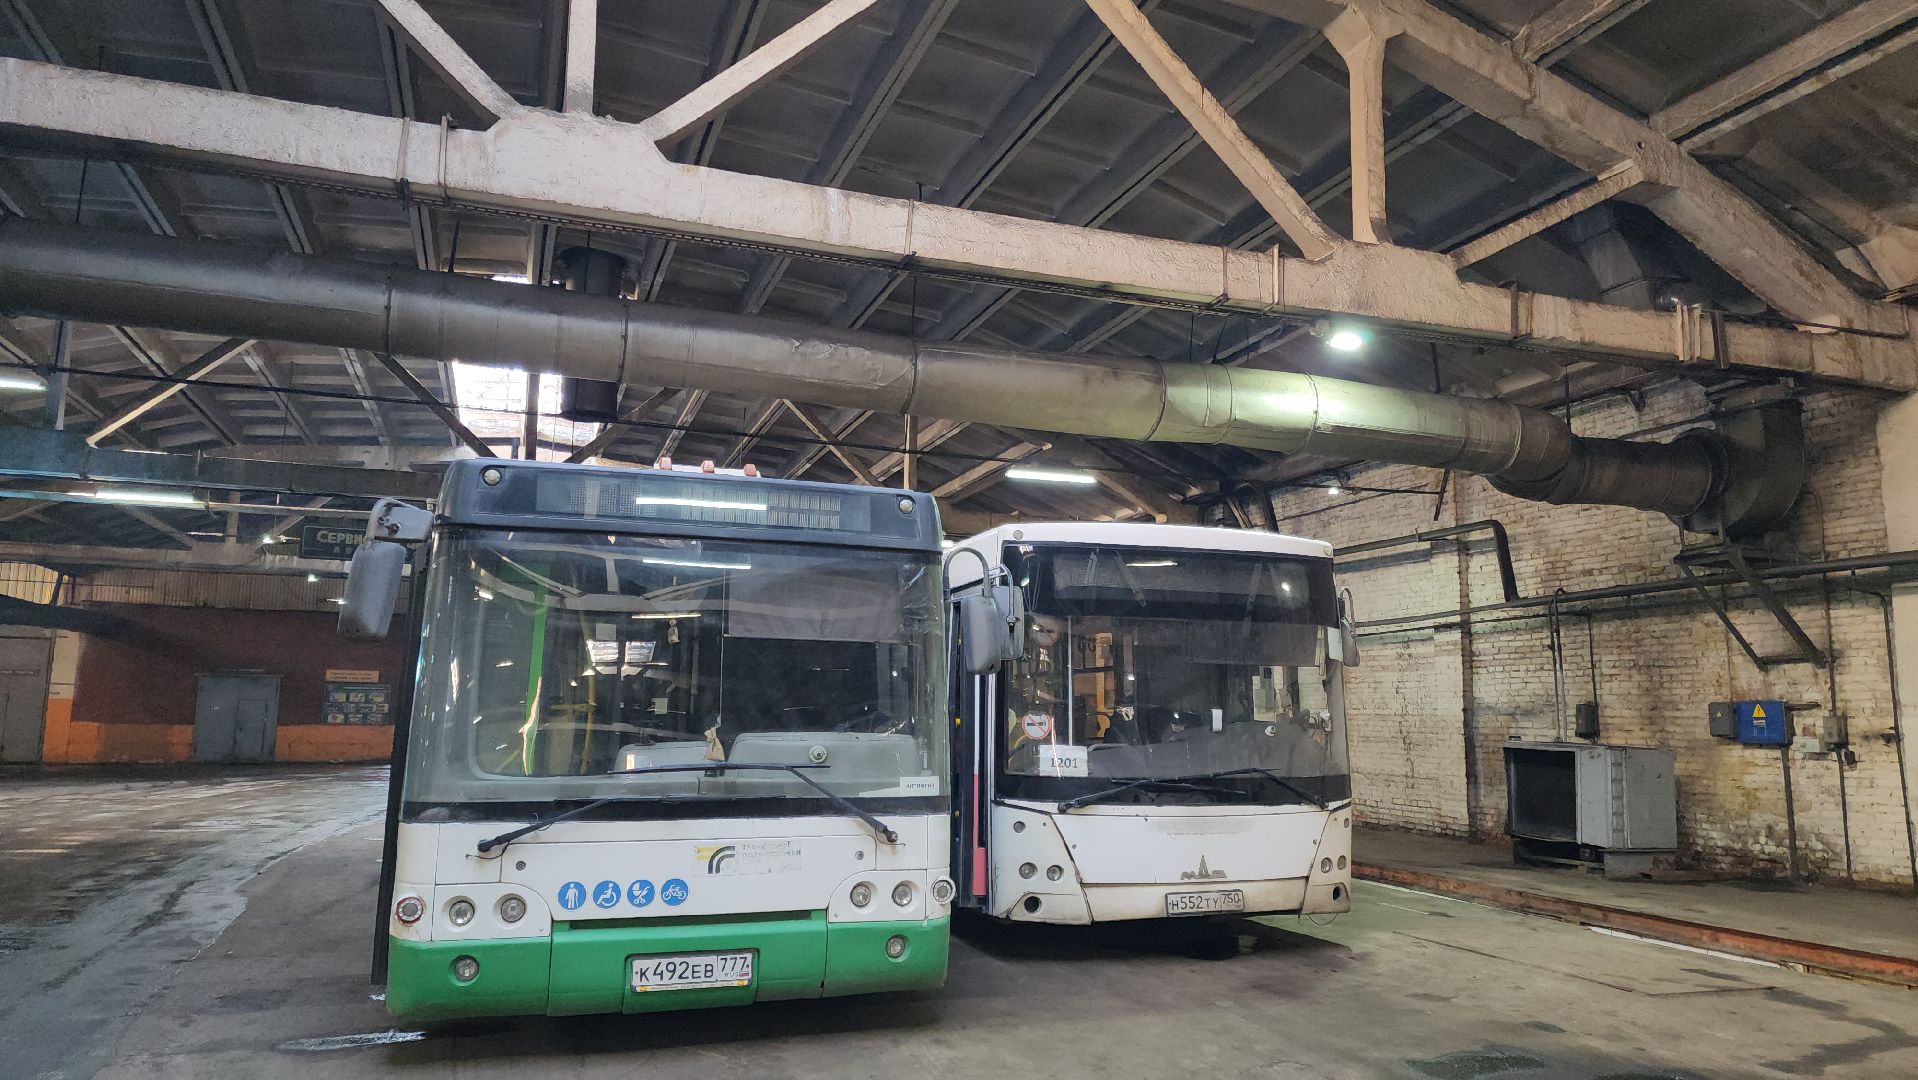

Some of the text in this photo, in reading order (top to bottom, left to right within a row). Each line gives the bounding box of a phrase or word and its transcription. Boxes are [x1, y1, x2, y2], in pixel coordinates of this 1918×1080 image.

[1050, 757, 1078, 769] 1201
[1171, 893, 1240, 911] Н552ТУ 750
[639, 957, 748, 983] К492ЕВ 777
